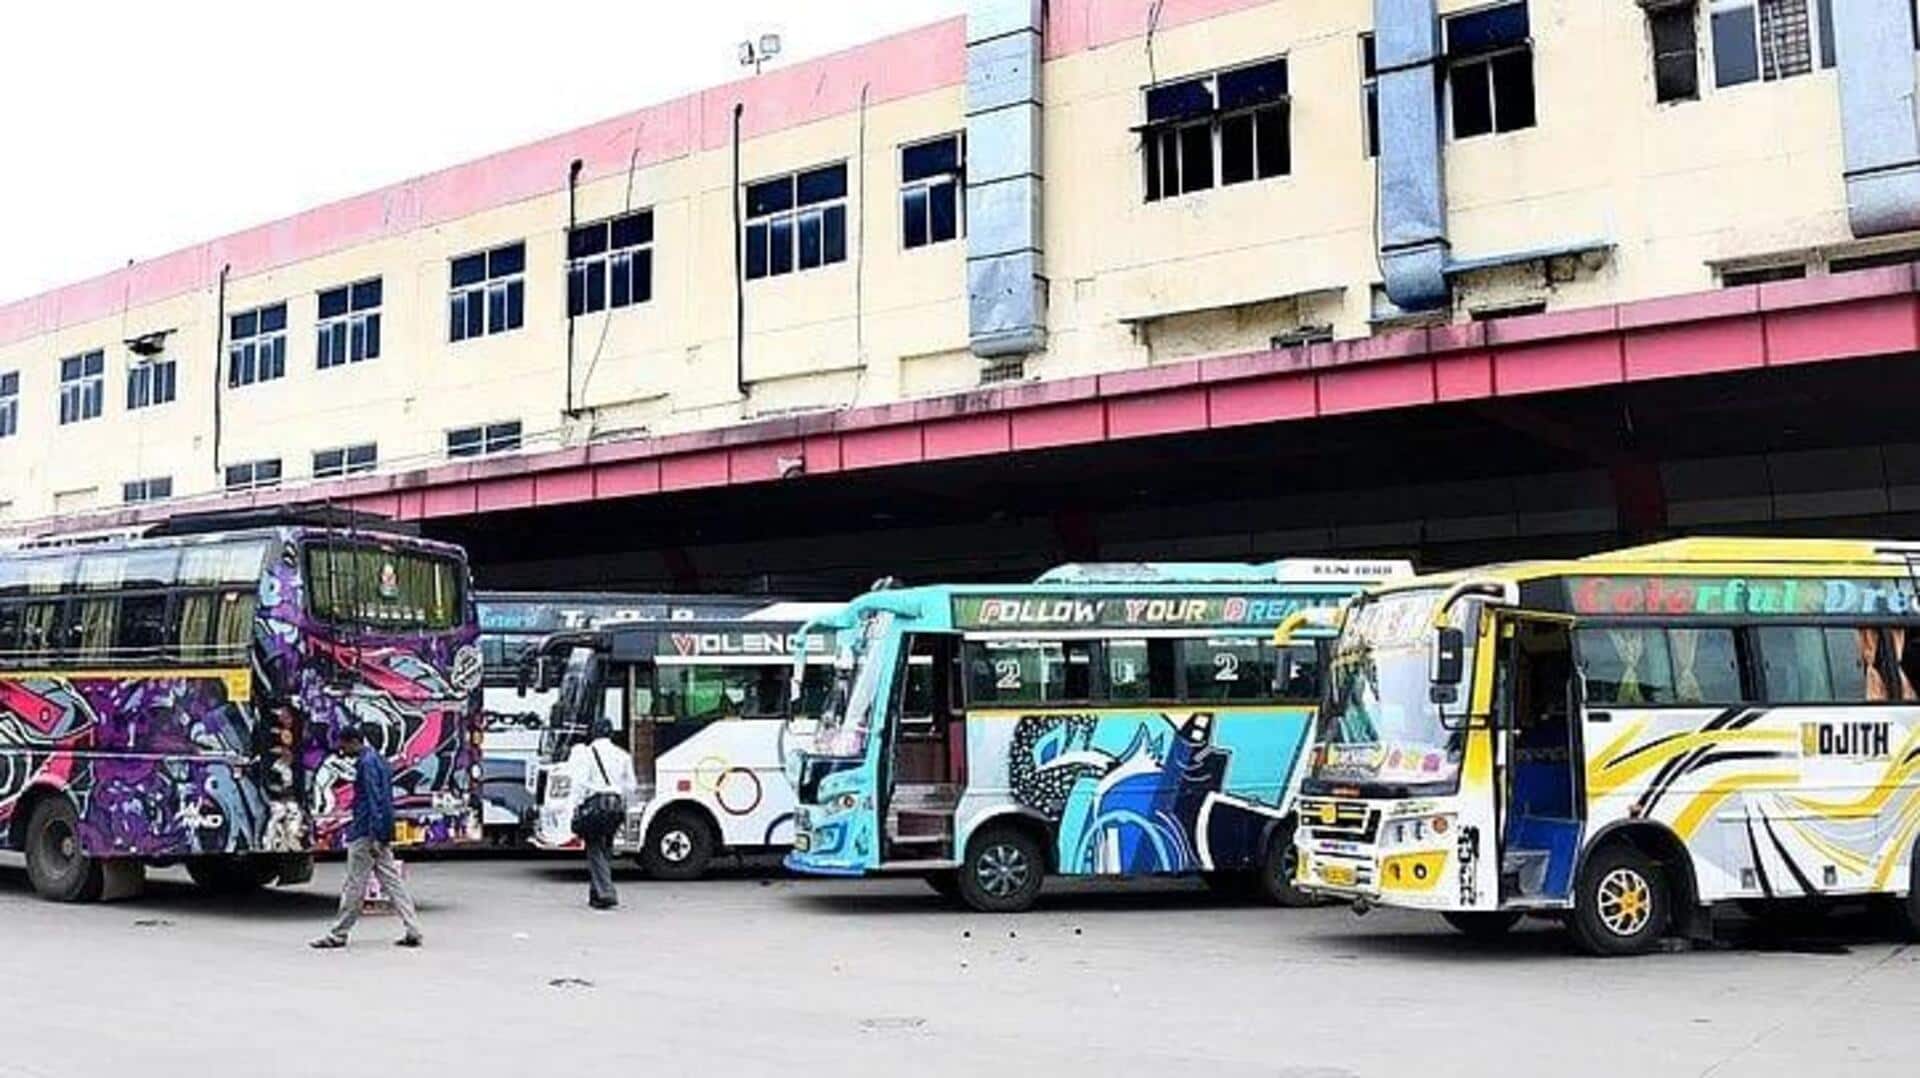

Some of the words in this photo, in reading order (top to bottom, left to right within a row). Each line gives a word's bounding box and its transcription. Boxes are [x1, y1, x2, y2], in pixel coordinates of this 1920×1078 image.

[978, 599, 1105, 623] FOLLOW
[1124, 599, 1208, 622] YOUR
[1574, 577, 1799, 615] Colorful
